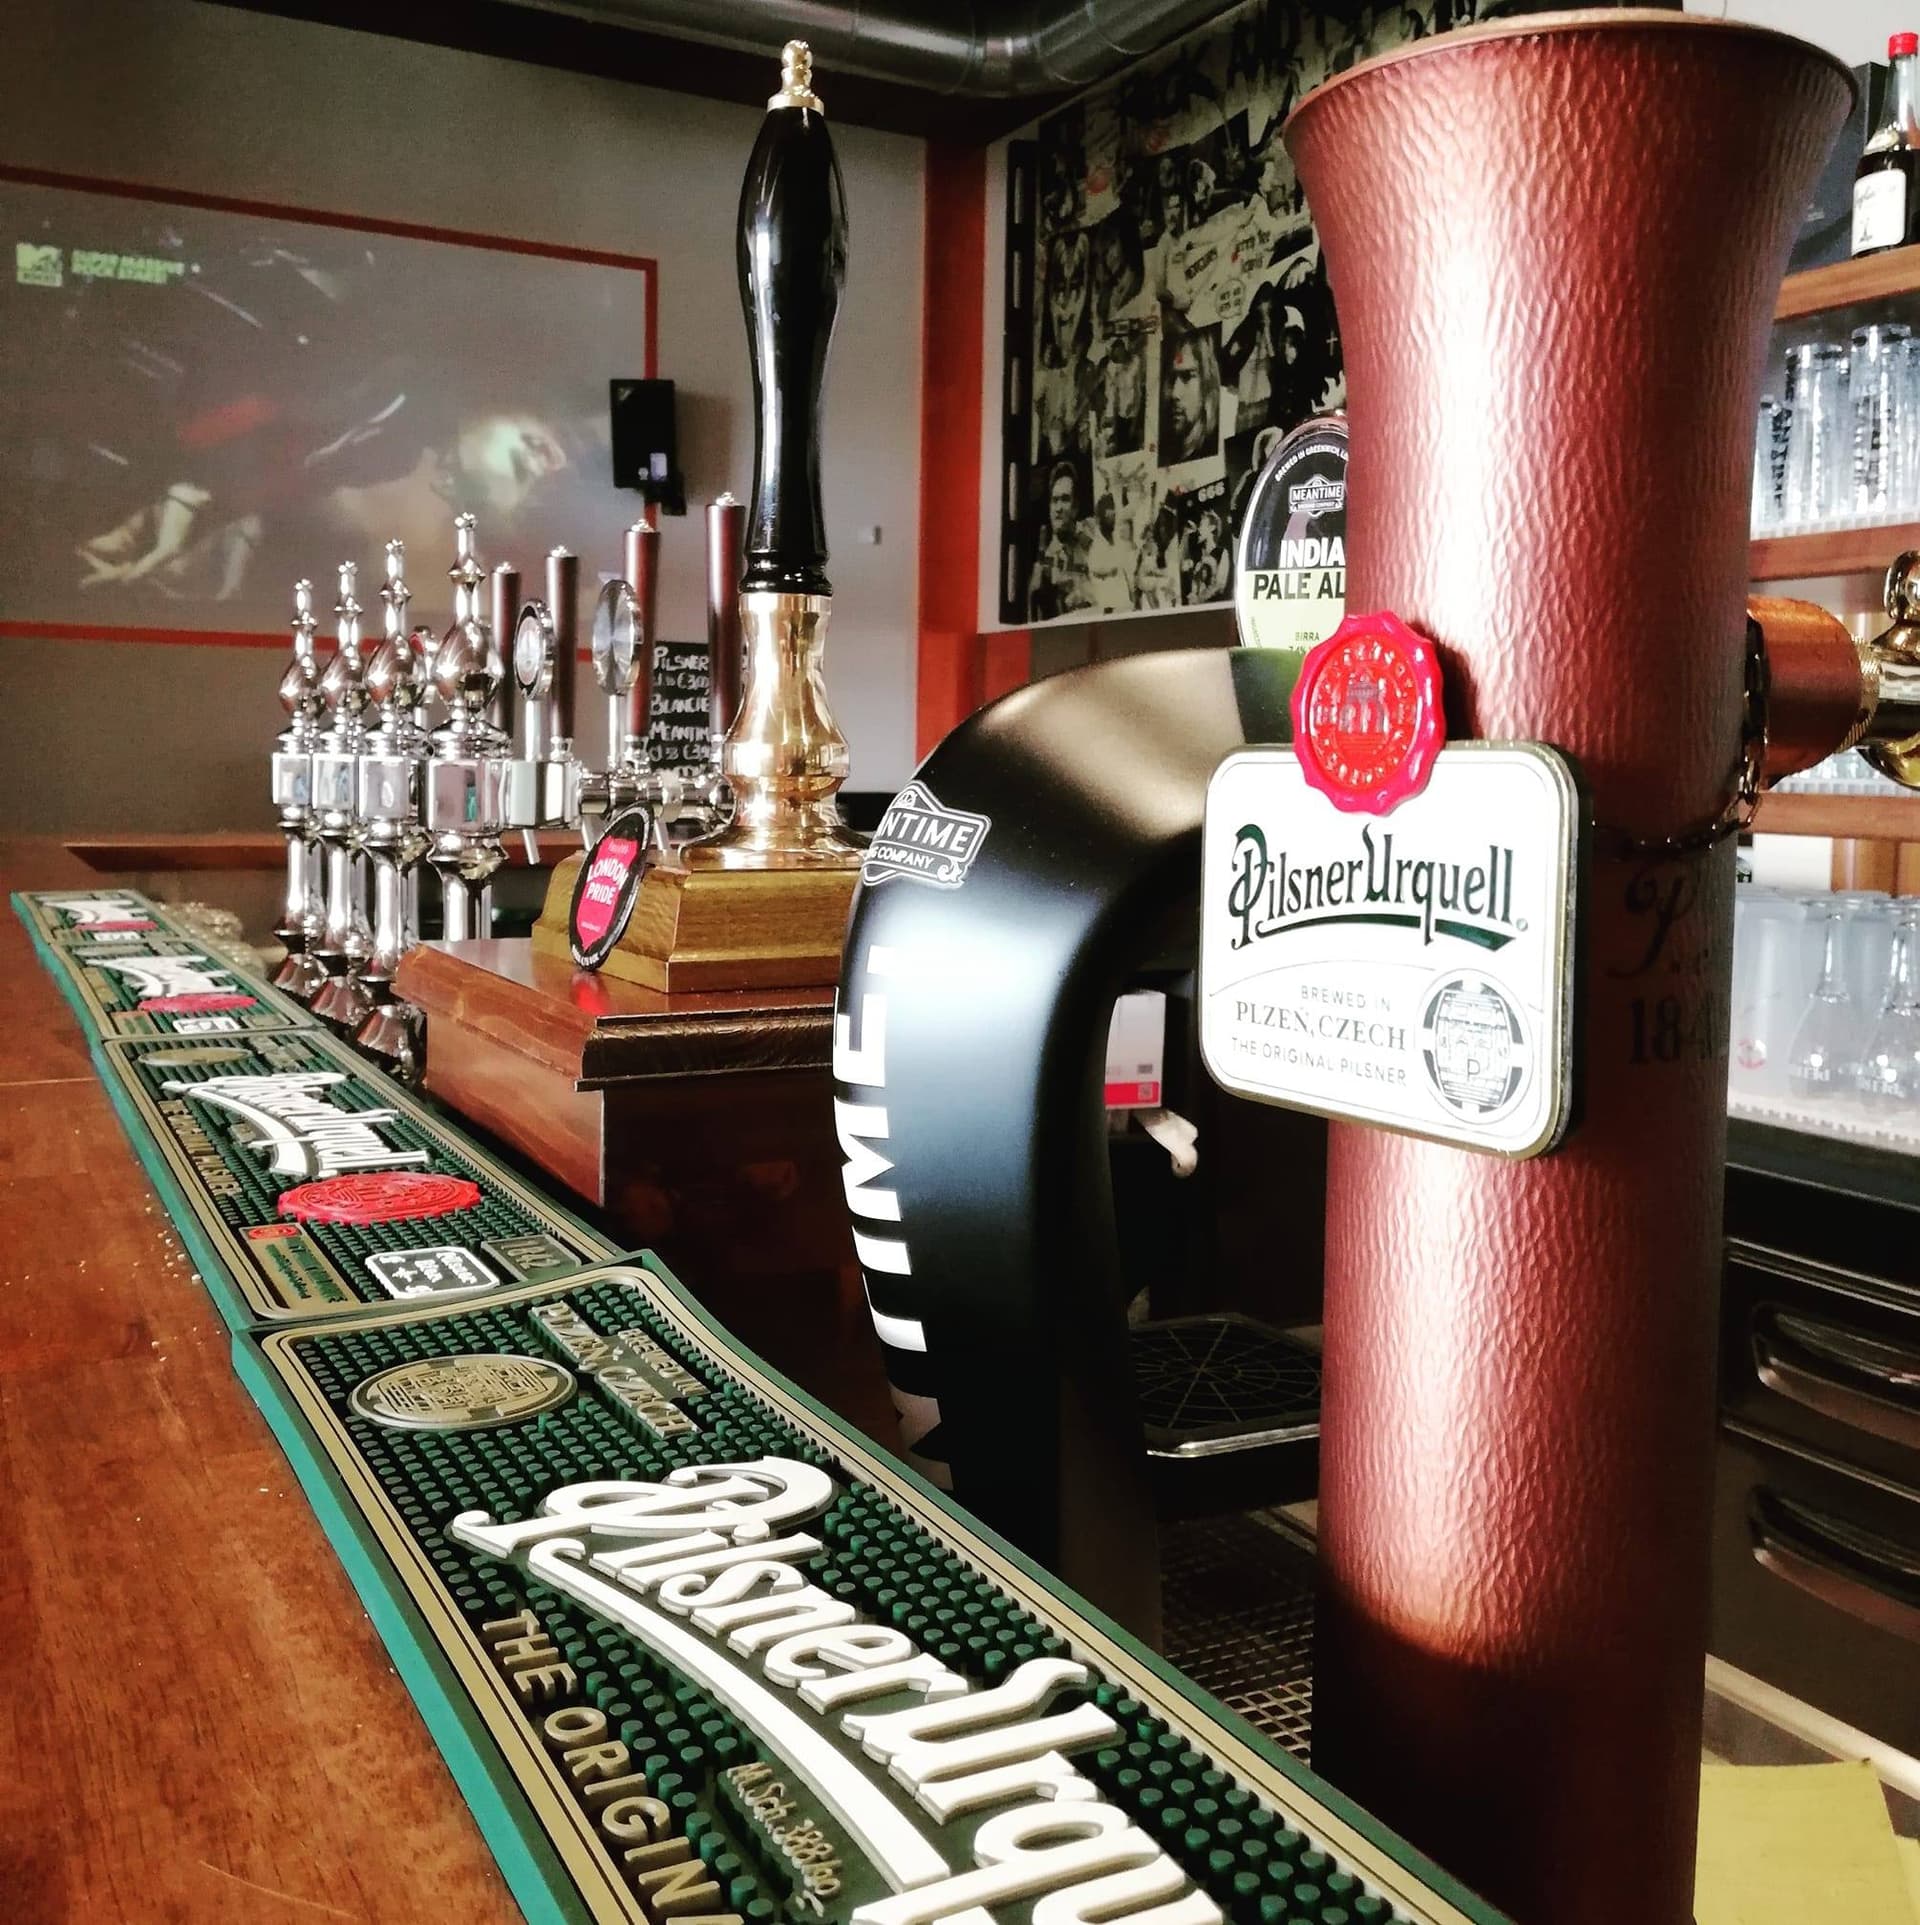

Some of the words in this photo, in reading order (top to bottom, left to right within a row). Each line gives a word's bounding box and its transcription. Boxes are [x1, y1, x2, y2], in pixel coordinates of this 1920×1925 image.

[1292, 485, 1342, 501] MEANTIME
[1279, 535, 1346, 569] INDIA
[1252, 573, 1311, 601] PALE
[1294, 631, 1320, 641] BIRRA
[652, 646, 709, 672] PILSNER
[586, 857, 630, 891] LONDON
[877, 846, 935, 870] COMPANY
[586, 884, 617, 906] PRIDE
[1227, 823, 1363, 951] Pilsner
[1361, 821, 1514, 947] Urquell
[1301, 985, 1367, 1009] BREWED
[1318, 1015, 1406, 1051] CZECH
[1231, 1037, 1257, 1055] THE
[1262, 1043, 1334, 1071] ORIGINAL
[1340, 1058, 1407, 1087] PILSNER
[598, 1365, 704, 1440] CZECH
[452, 1454, 969, 1714] Pilsner
[481, 1608, 578, 1699] THE
